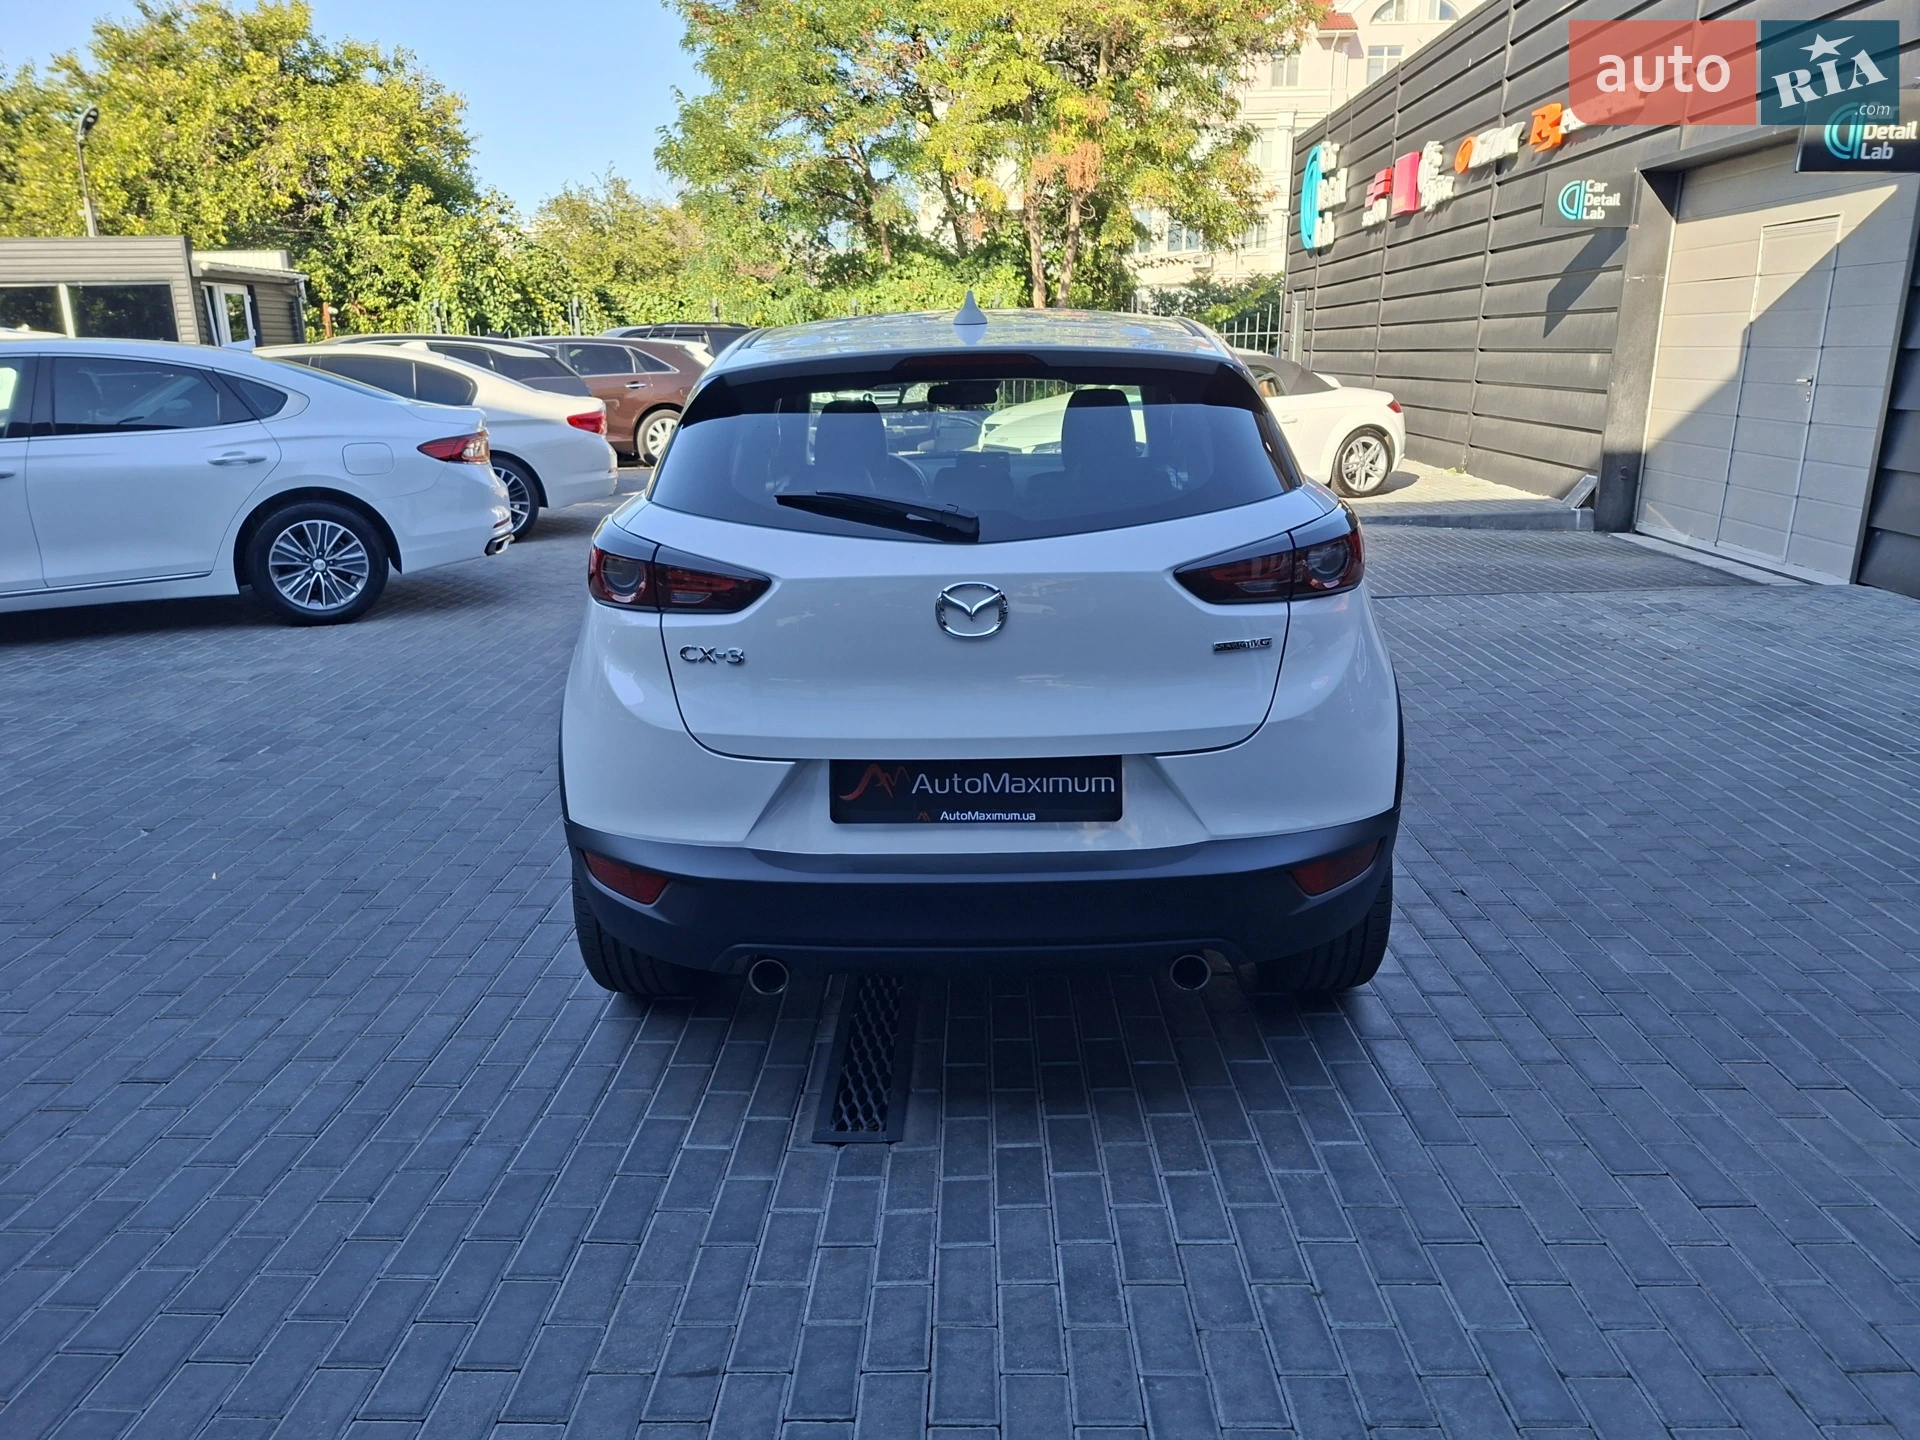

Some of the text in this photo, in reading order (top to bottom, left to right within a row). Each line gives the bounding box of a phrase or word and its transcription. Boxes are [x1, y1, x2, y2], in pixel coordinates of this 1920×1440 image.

[1862, 121, 1918, 140] Detail
[1860, 141, 1894, 160] Lab
[1585, 179, 1608, 193] Car
[1583, 192, 1621, 206] Detail
[1582, 206, 1606, 220] Lab
[679, 644, 745, 666] CX-3
[911, 772, 1116, 795] AutoMaximum
[940, 810, 1036, 822] AutoMaximum.ua
